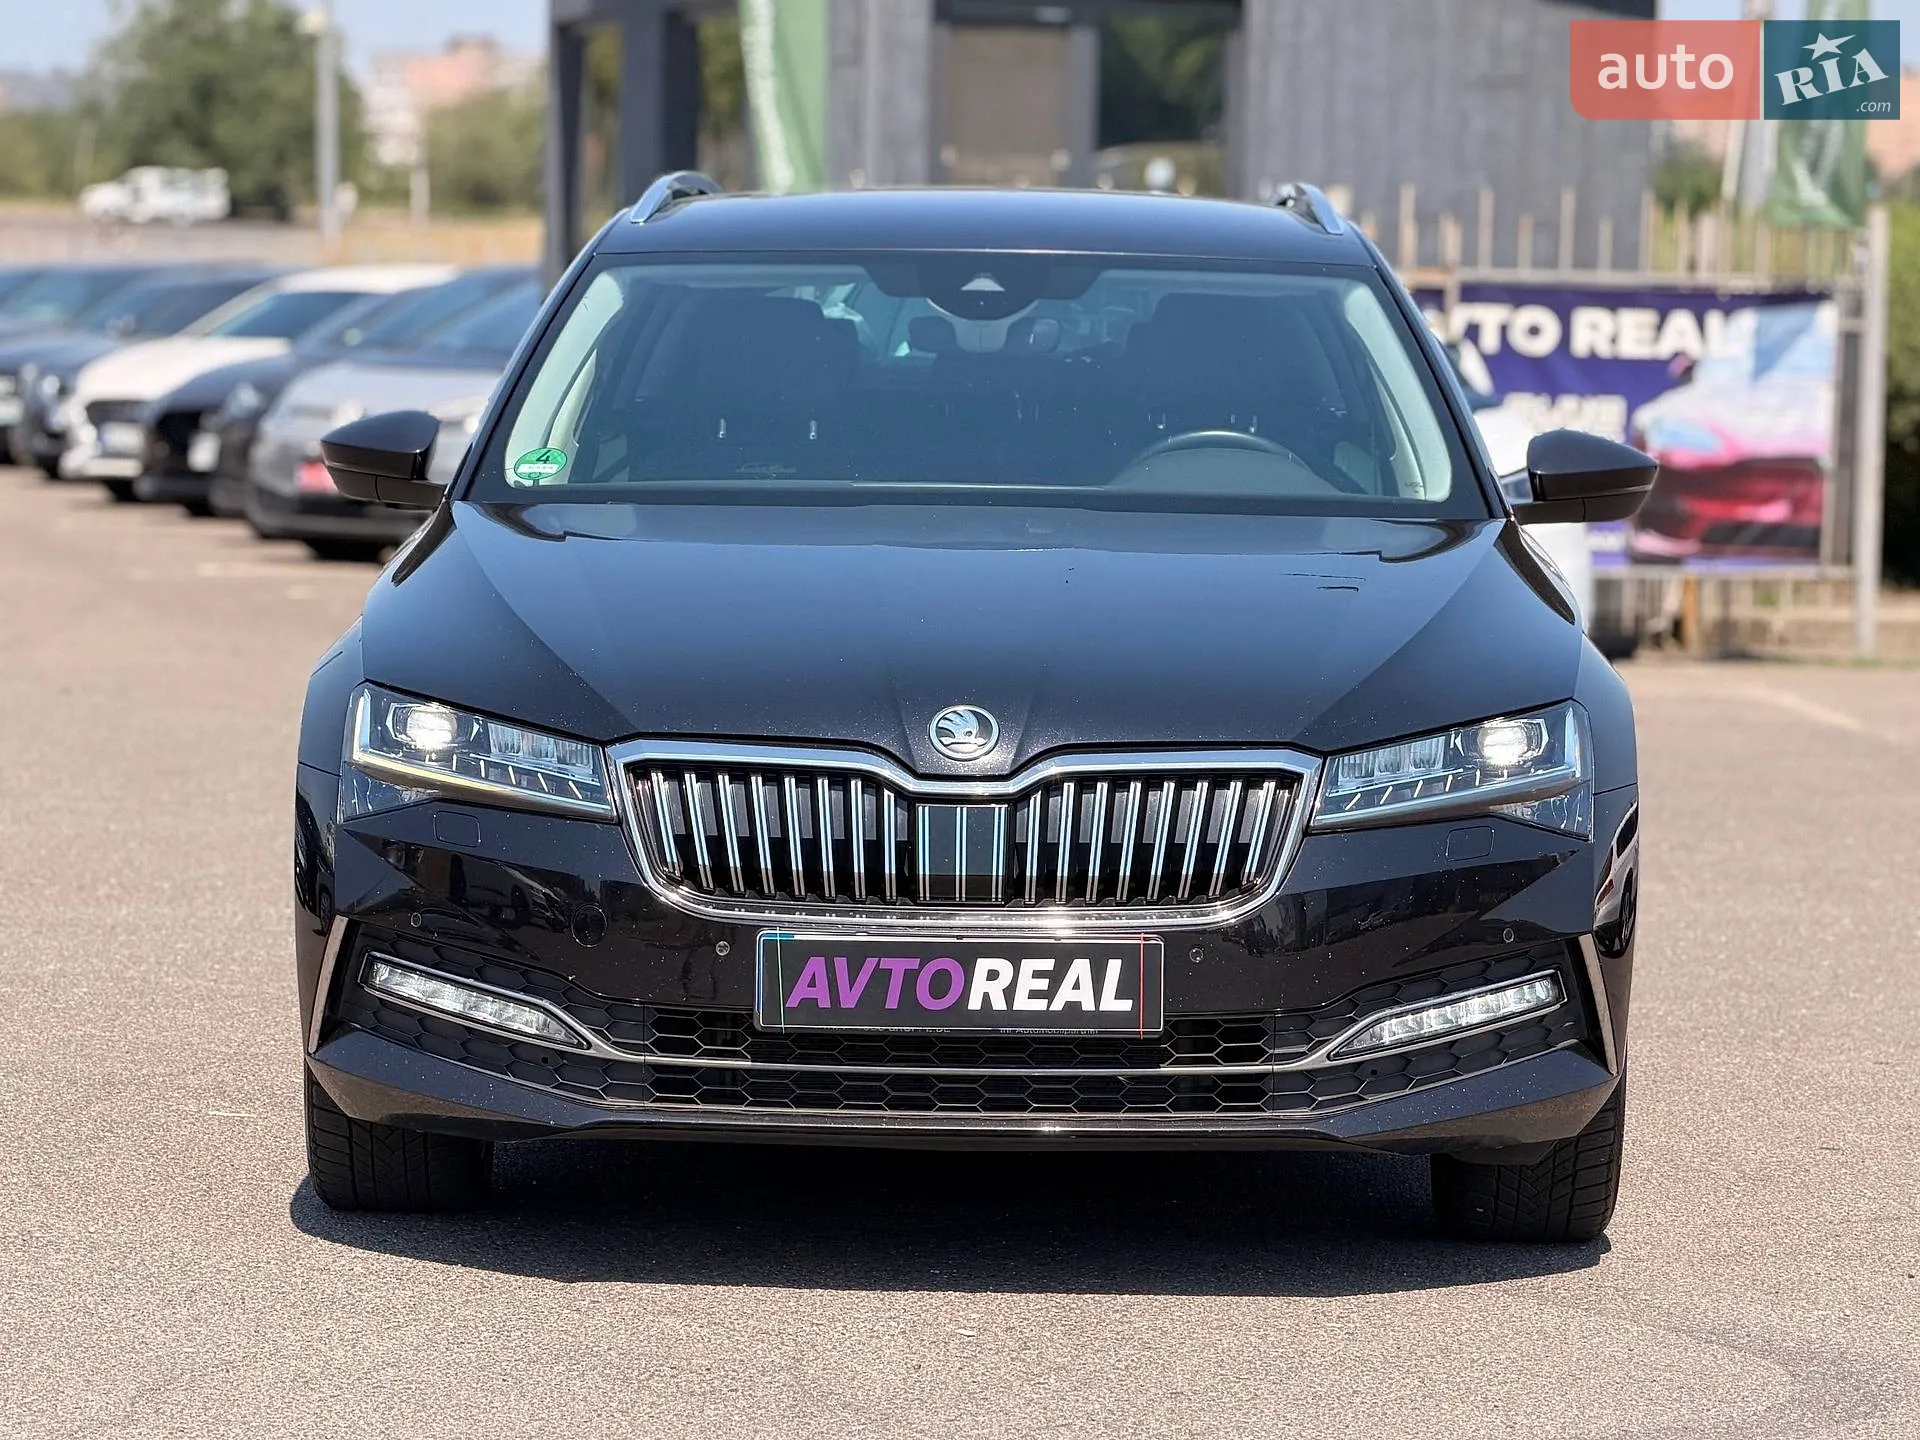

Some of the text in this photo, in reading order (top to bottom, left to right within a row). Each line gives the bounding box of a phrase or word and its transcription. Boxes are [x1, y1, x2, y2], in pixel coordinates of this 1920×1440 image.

[1569, 307, 1746, 360] REAL
[536, 450, 552, 464] 4
[786, 956, 1133, 1011] AVTOREAL
